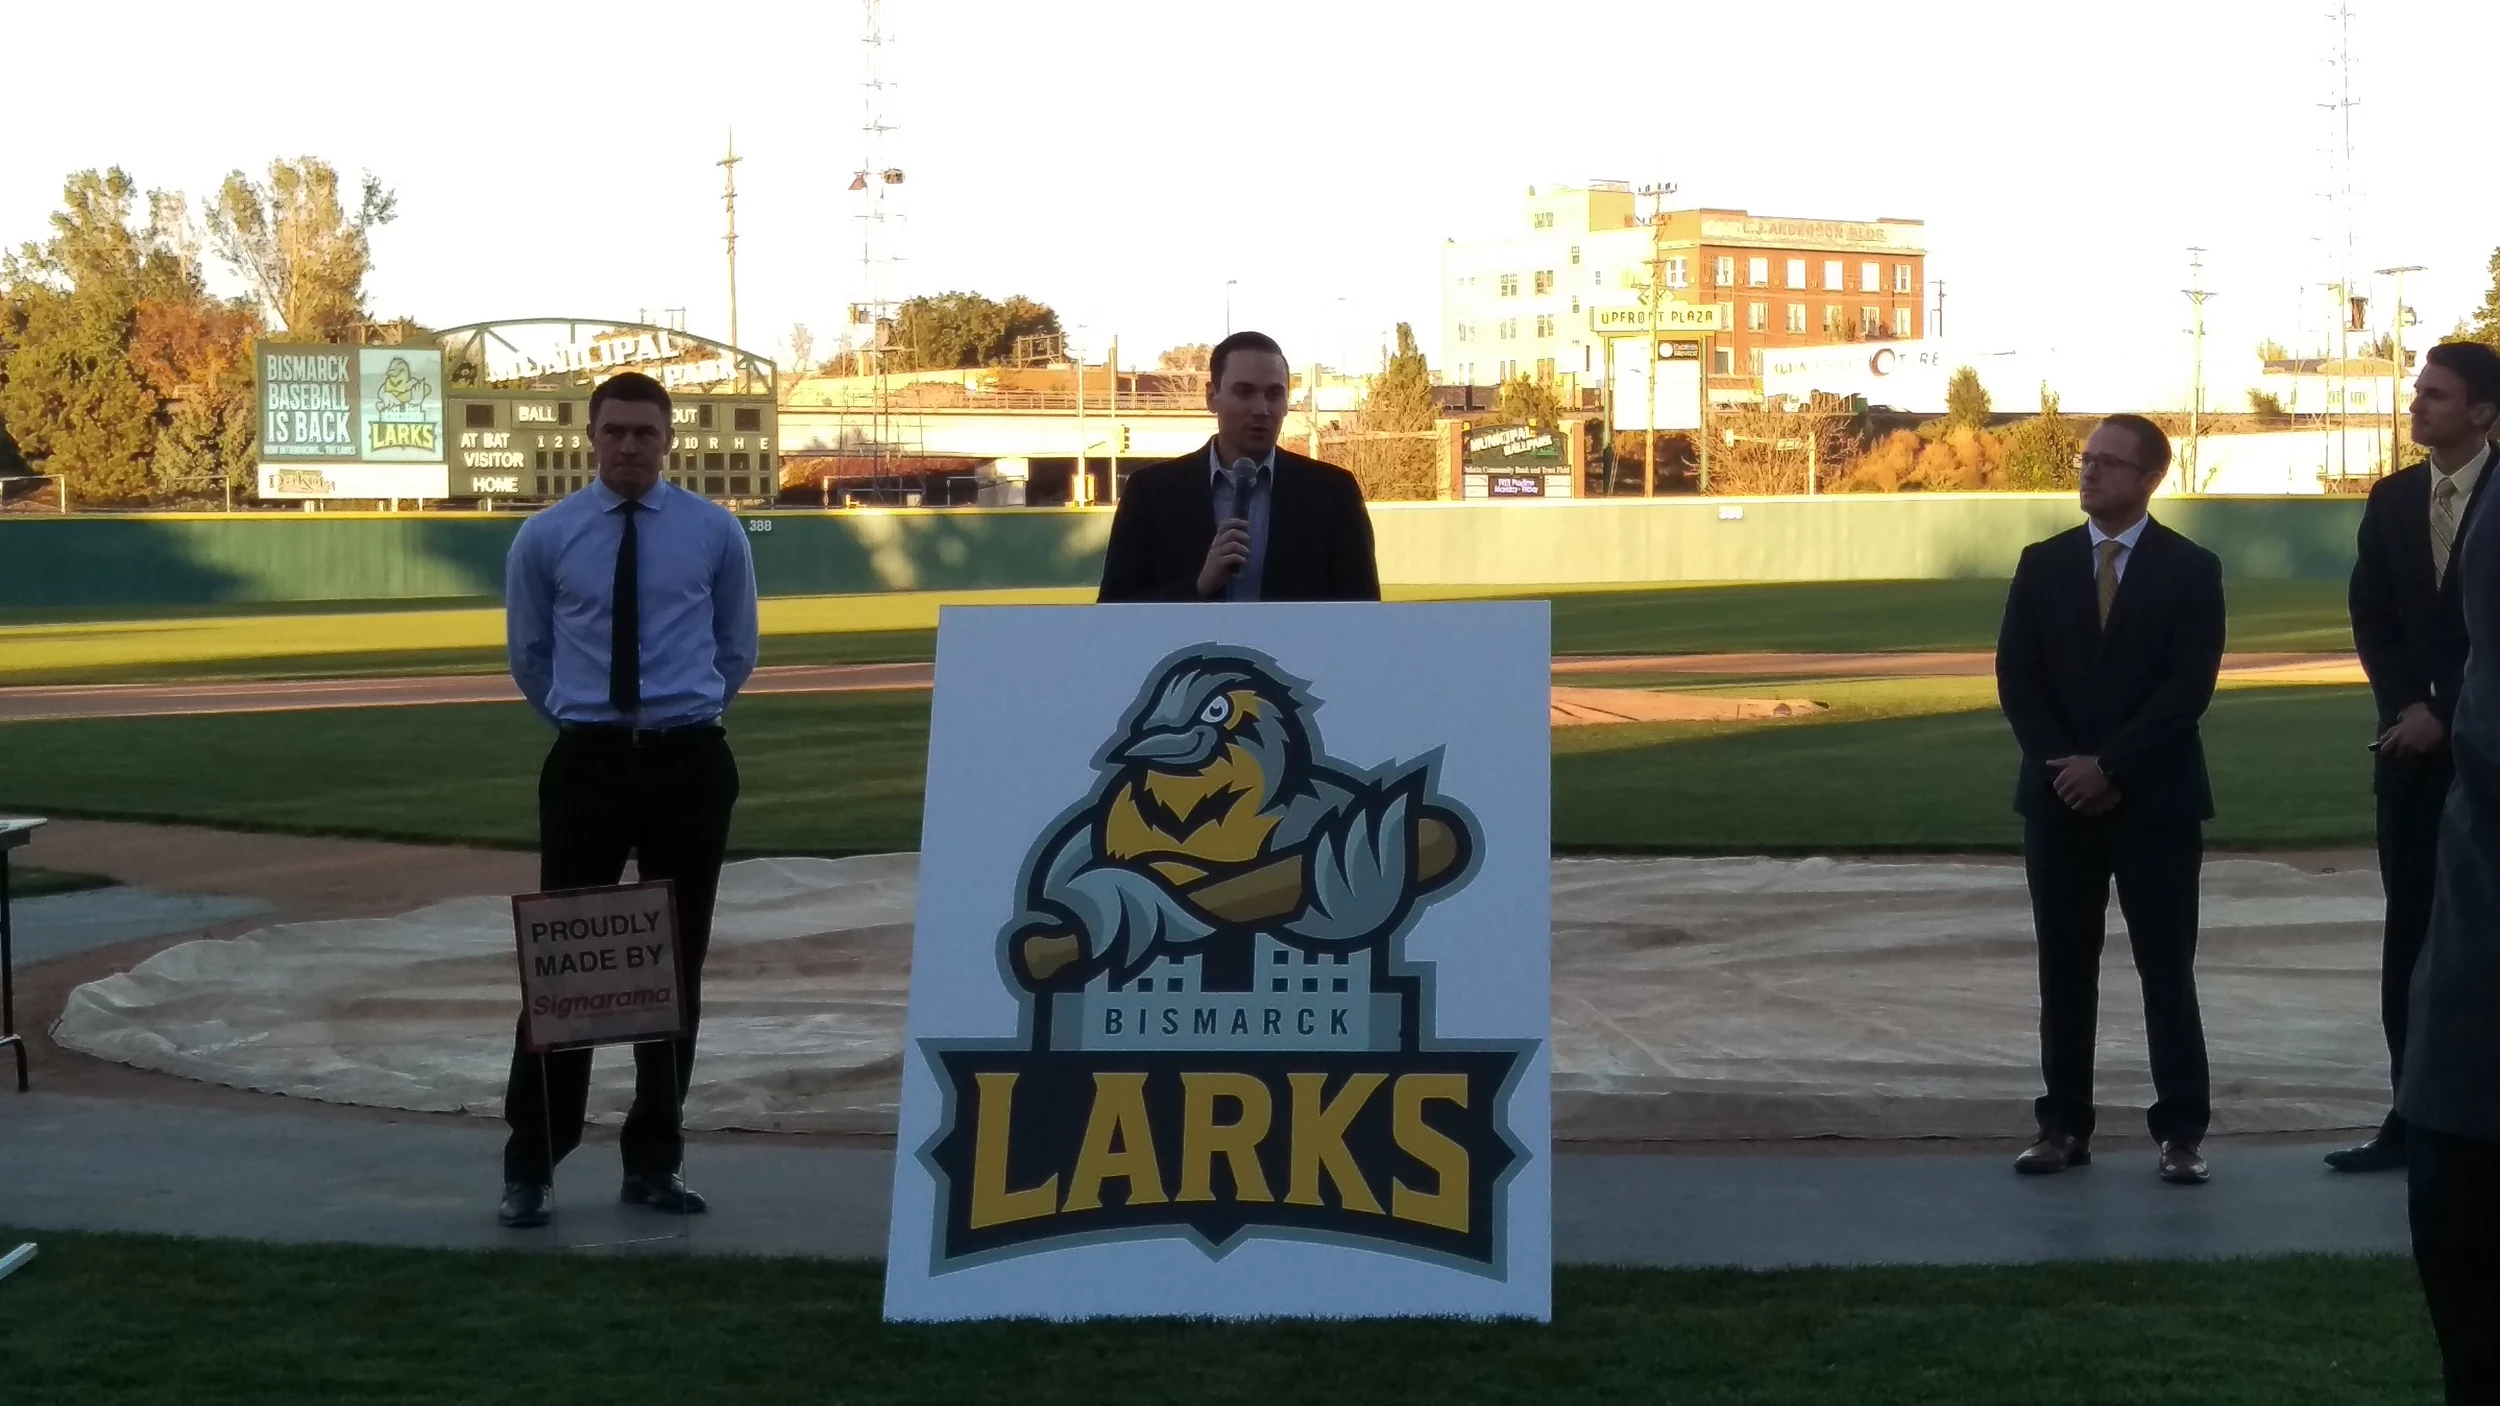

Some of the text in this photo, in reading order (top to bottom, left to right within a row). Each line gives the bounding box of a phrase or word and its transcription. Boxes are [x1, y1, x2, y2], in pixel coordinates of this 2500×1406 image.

[1671, 311, 1713, 323] PLAZA
[267, 354, 350, 382] BISMARCK
[268, 382, 350, 411] BASEBALL
[518, 406, 557, 422] BALL
[672, 408, 698, 423] OUT
[268, 411, 351, 443] IS BACK
[372, 424, 434, 447] LARKS
[460, 432, 511, 448] AT BAT
[537, 435, 545, 448] 1
[554, 435, 563, 448] 2
[571, 435, 580, 448] 3
[684, 437, 699, 449] 10
[709, 437, 718, 449] R
[734, 437, 744, 449] H
[760, 437, 769, 449] E
[463, 452, 525, 468] VISITOR
[473, 477, 519, 492] HOME
[749, 519, 772, 531] 388
[532, 911, 660, 943] PROUDLY
[534, 944, 663, 978] MADE BY
[533, 987, 671, 1019] Signarama
[1105, 1008, 1350, 1036] BISMARCK
[970, 1072, 1470, 1234] LARKS
